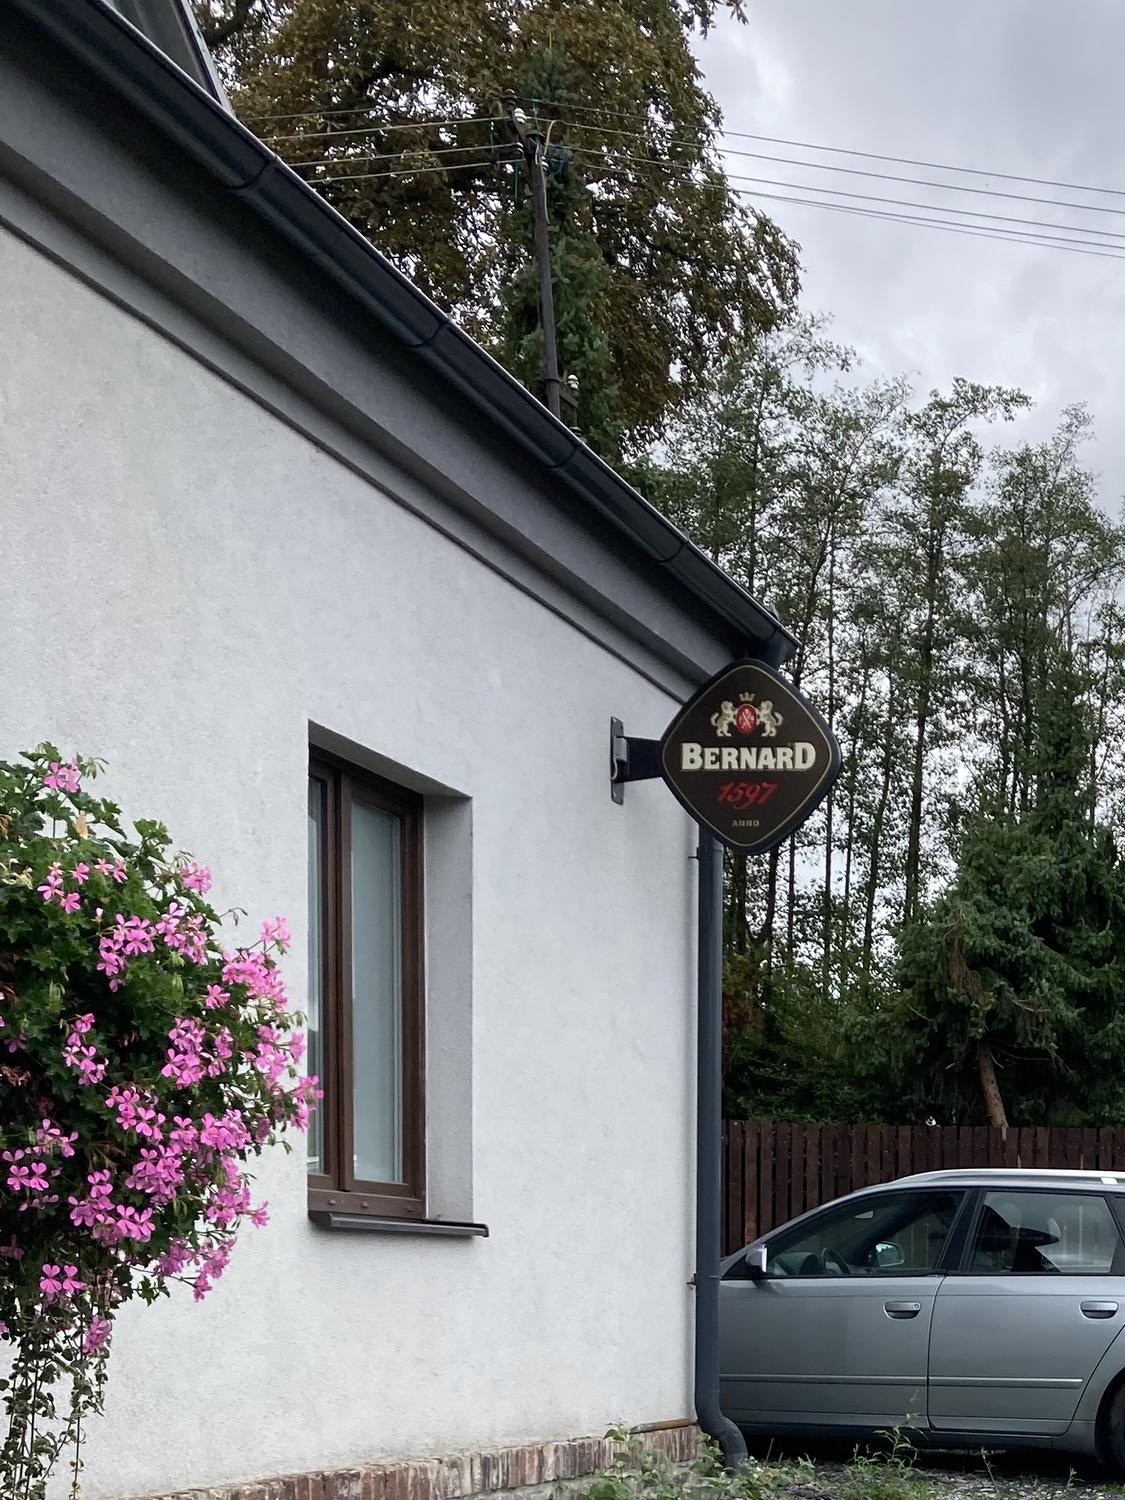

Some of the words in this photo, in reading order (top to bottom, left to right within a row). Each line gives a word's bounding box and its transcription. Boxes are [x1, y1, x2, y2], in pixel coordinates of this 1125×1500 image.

[680, 742, 816, 770] BERNARD
[718, 782, 778, 810] 1597
[732, 819, 760, 828] ANNO
